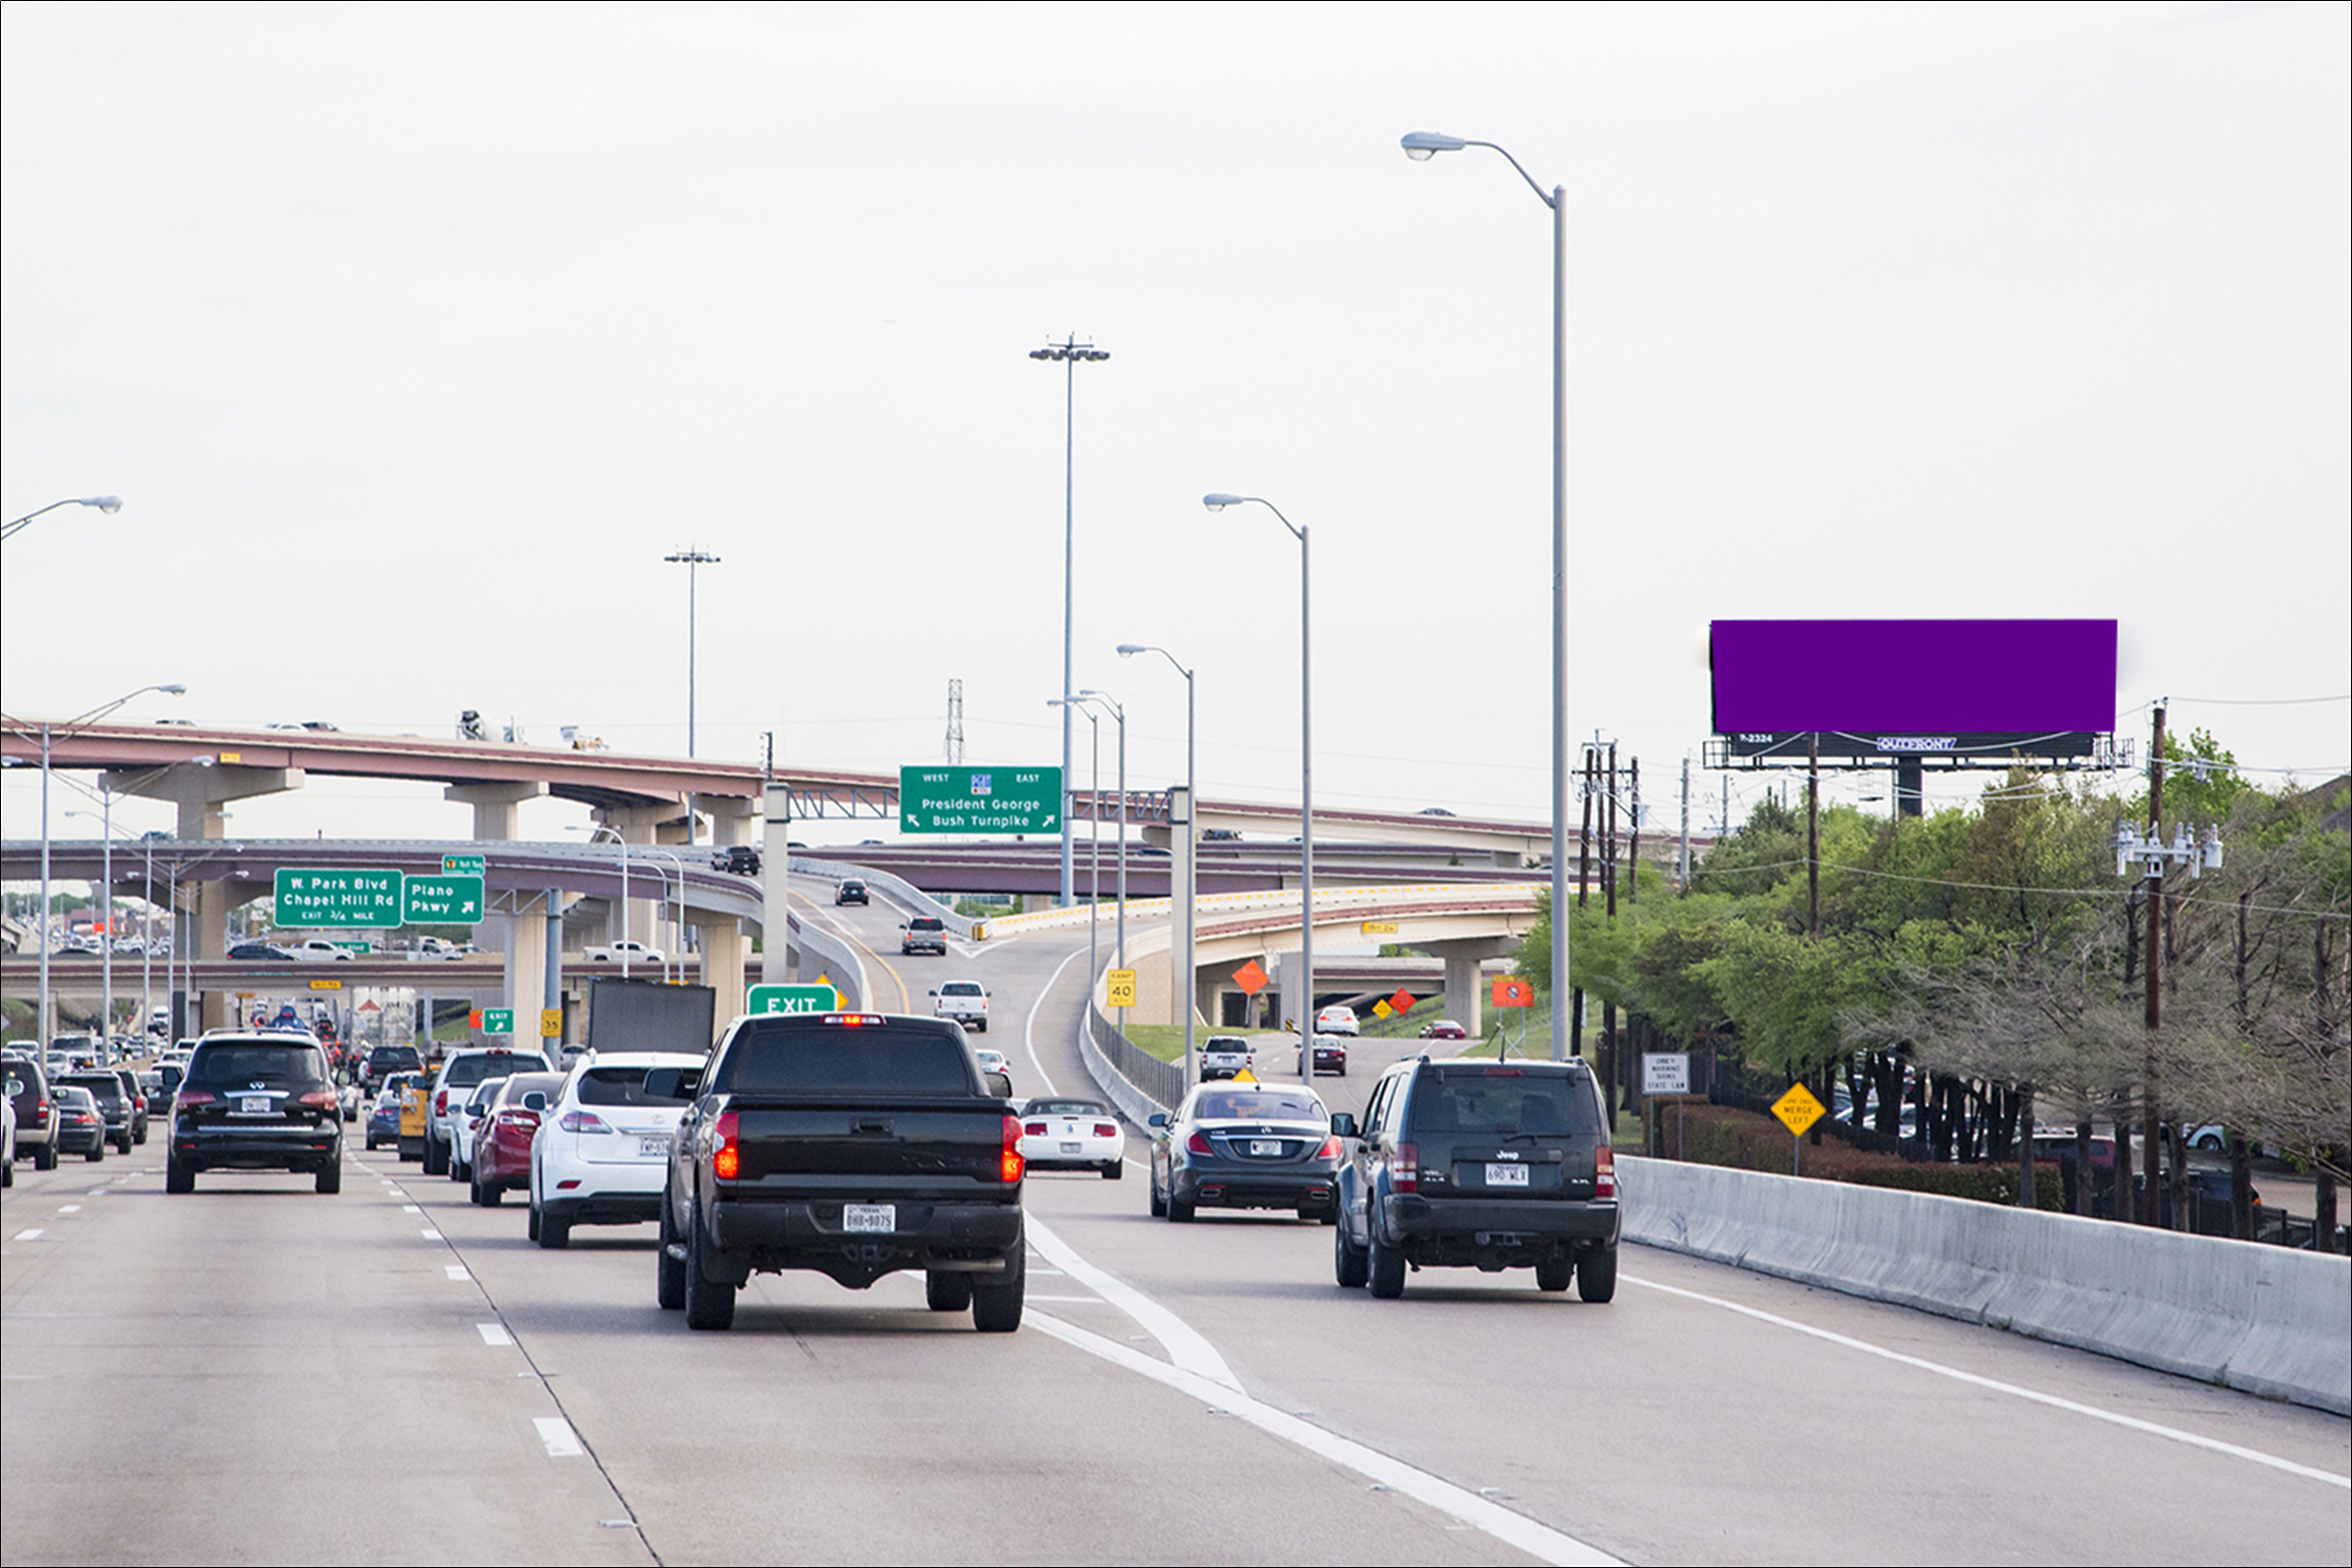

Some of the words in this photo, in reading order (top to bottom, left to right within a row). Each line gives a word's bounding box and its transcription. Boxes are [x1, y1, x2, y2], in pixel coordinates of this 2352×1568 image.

[1880, 738, 1953, 750] OUTFRONT
[922, 773, 950, 782] WEST
[1015, 773, 1040, 782] EAST
[921, 799, 986, 809] President
[992, 799, 1041, 812] George
[932, 815, 964, 826] Bush
[970, 815, 1030, 828] Turnpike
[312, 877, 347, 889] Park
[354, 878, 388, 890] Blvd
[412, 884, 454, 896] Plano
[283, 894, 335, 908] Chapel
[341, 894, 368, 906] Hill
[374, 895, 394, 906] Rd
[412, 900, 450, 914] Pkwy
[301, 910, 322, 920] EXIT
[329, 909, 346, 921] 3/4
[353, 911, 375, 920] MILE
[1112, 985, 1132, 997] 40
[767, 998, 817, 1013] EXIT
[545, 1020, 559, 1030] 35
[1496, 1150, 1519, 1160] Jeep
